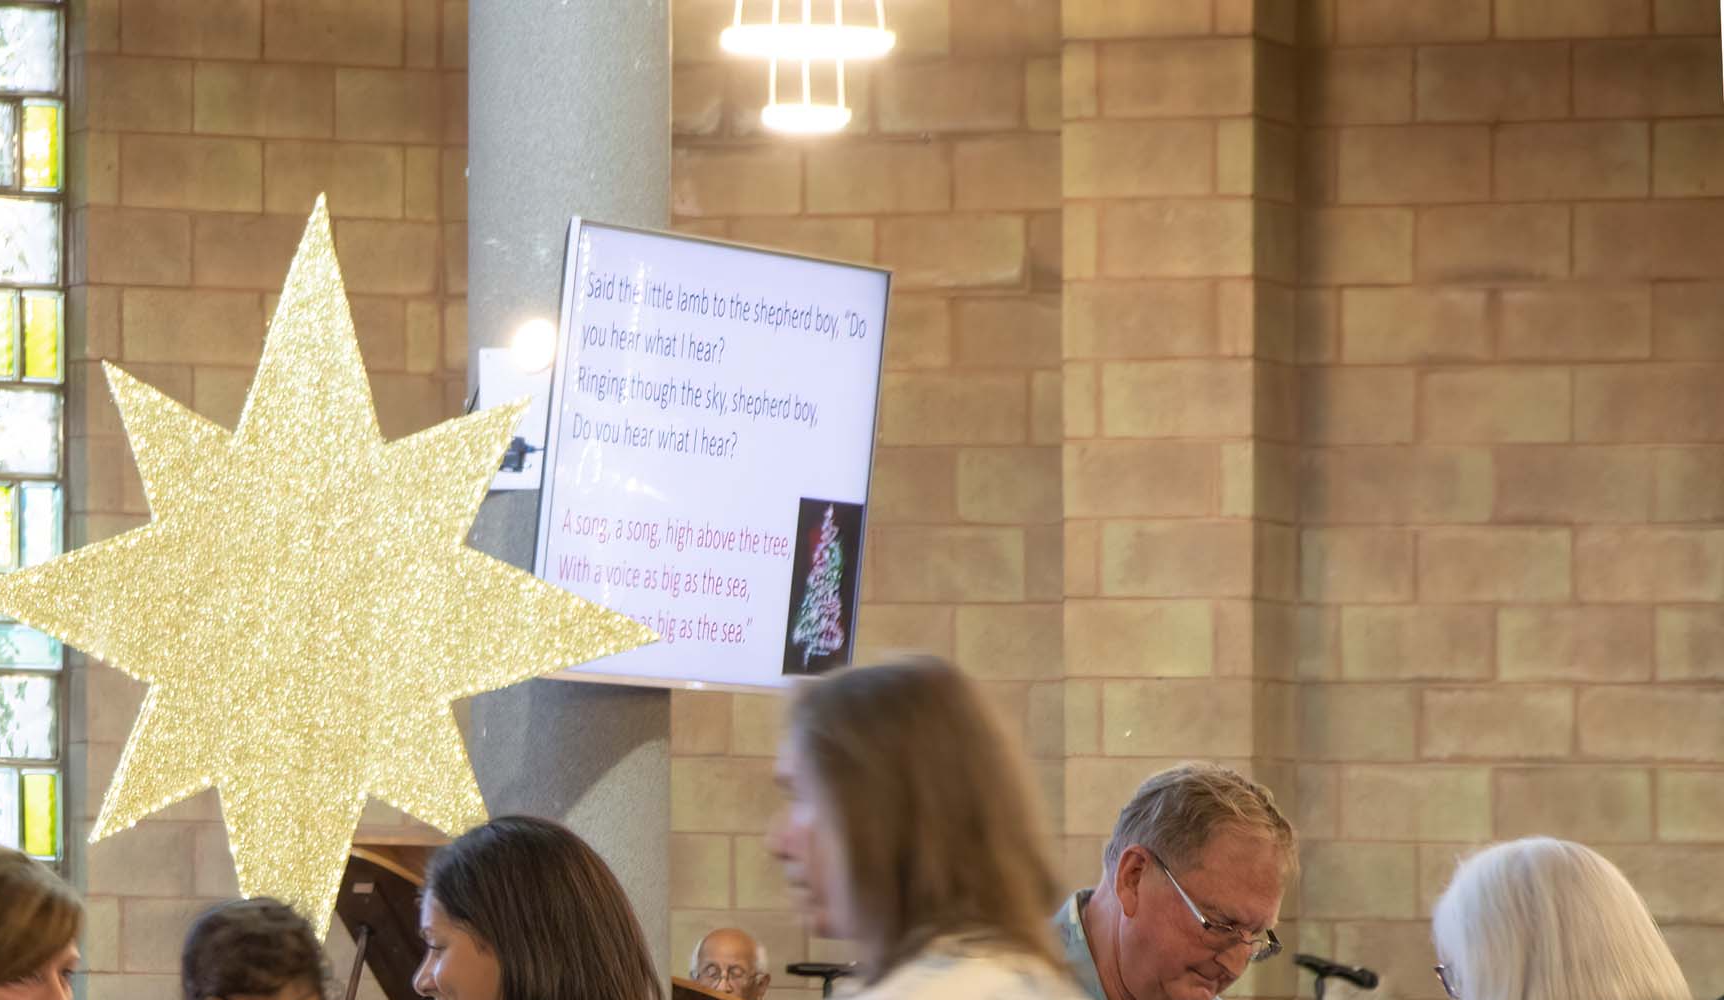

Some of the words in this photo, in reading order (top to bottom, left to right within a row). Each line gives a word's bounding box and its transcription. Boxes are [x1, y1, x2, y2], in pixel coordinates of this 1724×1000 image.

[587, 271, 616, 300] Said
[643, 279, 674, 311] little
[677, 283, 709, 315] lamb
[713, 291, 726, 318] to
[730, 293, 751, 322] the
[753, 297, 813, 332] shepherd
[815, 306, 840, 341] boy,
[582, 323, 607, 351] you
[610, 320, 641, 352] hear
[644, 328, 677, 358] what
[680, 333, 685, 359] I
[687, 332, 725, 364] hear?
[579, 366, 627, 404] Ringing
[630, 371, 677, 410] though
[681, 379, 702, 408] the
[705, 381, 728, 416] sky,
[732, 384, 791, 422] shepherd
[794, 393, 819, 428] boy,
[572, 412, 592, 441] Do
[623, 418, 654, 449] hear
[658, 424, 689, 454] what
[693, 428, 698, 455] I
[700, 427, 738, 460] hear?
[562, 507, 573, 535] A
[575, 515, 612, 544] song,
[615, 519, 624, 540] a
[626, 520, 662, 550] song,
[665, 518, 693, 552] high
[697, 521, 736, 551] above
[739, 526, 760, 554] the
[763, 531, 791, 560] tree,
[559, 554, 591, 583] With
[594, 564, 603, 584] a
[606, 560, 640, 588] voice
[643, 569, 658, 590] as
[661, 562, 681, 598] big
[684, 573, 698, 594] as
[702, 568, 723, 596] the
[726, 576, 750, 603] sea,
[657, 609, 677, 644] big
[679, 619, 693, 640] as
[697, 613, 718, 641] the
